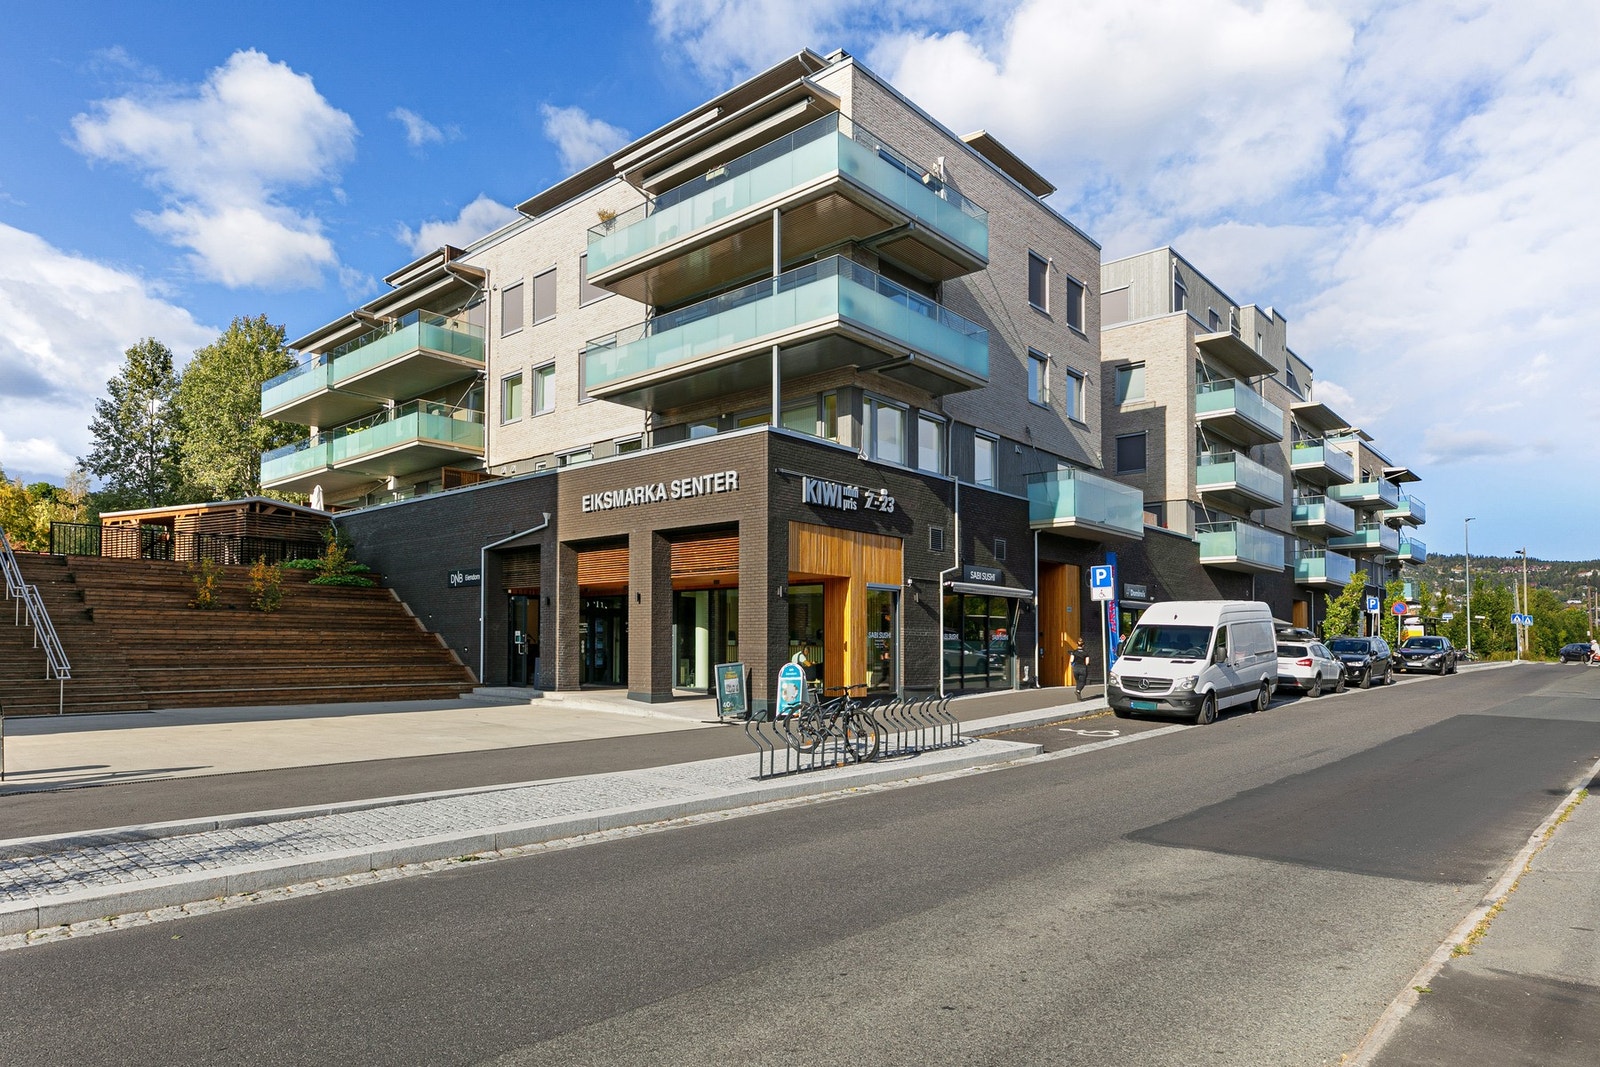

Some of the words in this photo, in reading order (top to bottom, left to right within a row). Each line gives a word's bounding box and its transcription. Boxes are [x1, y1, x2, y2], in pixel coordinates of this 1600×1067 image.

[582, 483, 668, 512] EIKSMARKA
[671, 470, 739, 499] SENTER
[802, 476, 842, 509] KIWI
[843, 497, 858, 511] pris
[450, 570, 464, 587] DNB
[970, 571, 982, 580] SABI
[982, 573, 996, 581] SUSHI
[1096, 569, 1107, 586] P
[1370, 599, 1376, 608] P
